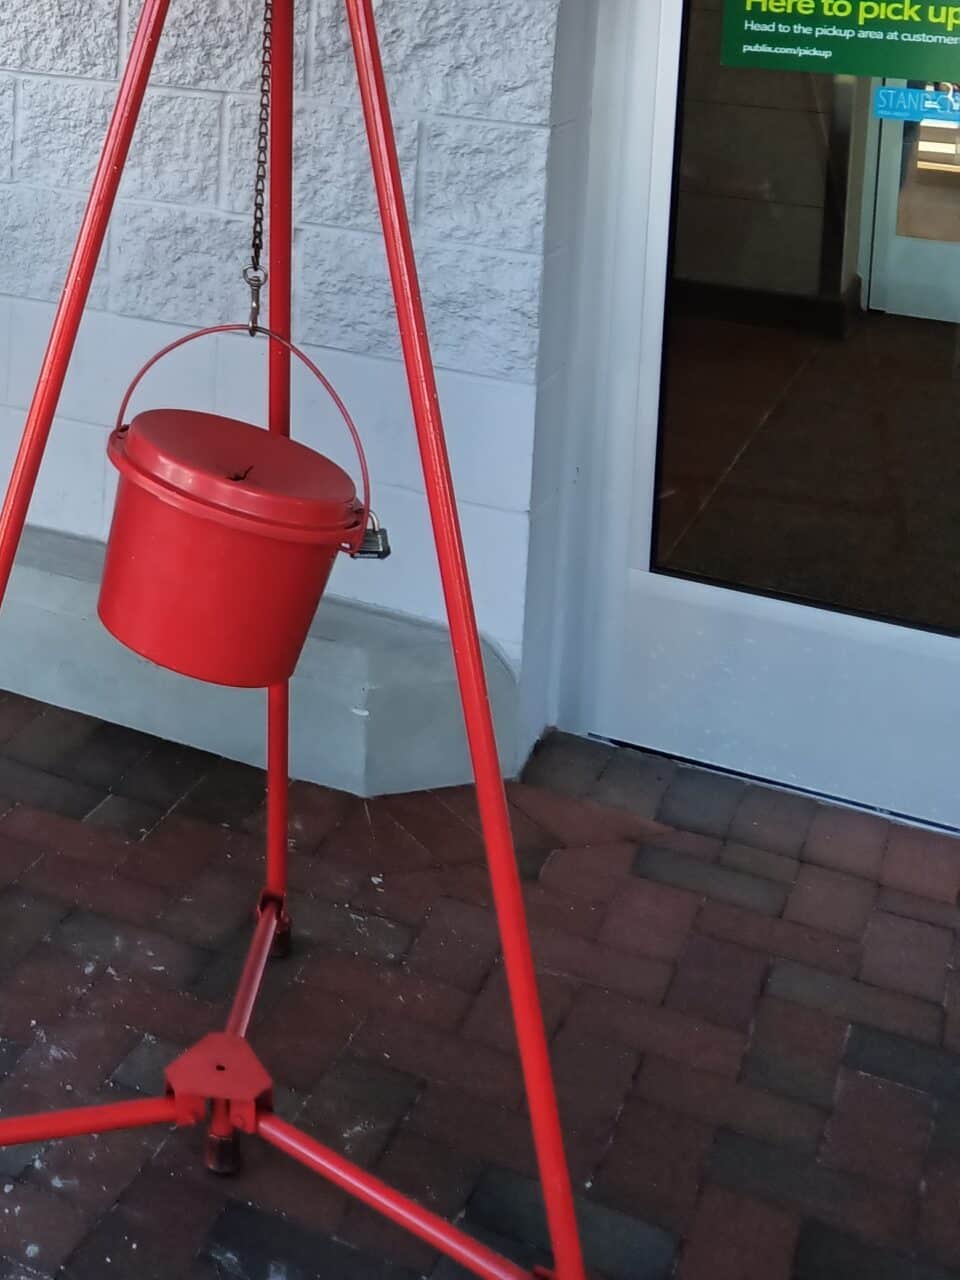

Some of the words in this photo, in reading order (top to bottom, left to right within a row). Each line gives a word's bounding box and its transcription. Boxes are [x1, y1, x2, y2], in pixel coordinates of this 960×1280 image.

[928, 5, 960, 31] up
[744, 19, 775, 32] Head
[778, 22, 790, 33] to
[792, 22, 813, 34] the
[815, 24, 855, 39] pickup
[857, 28, 883, 39] area
[886, 30, 898, 40] at
[900, 31, 960, 45] customer
[742, 43, 832, 59] publix.com/pickup
